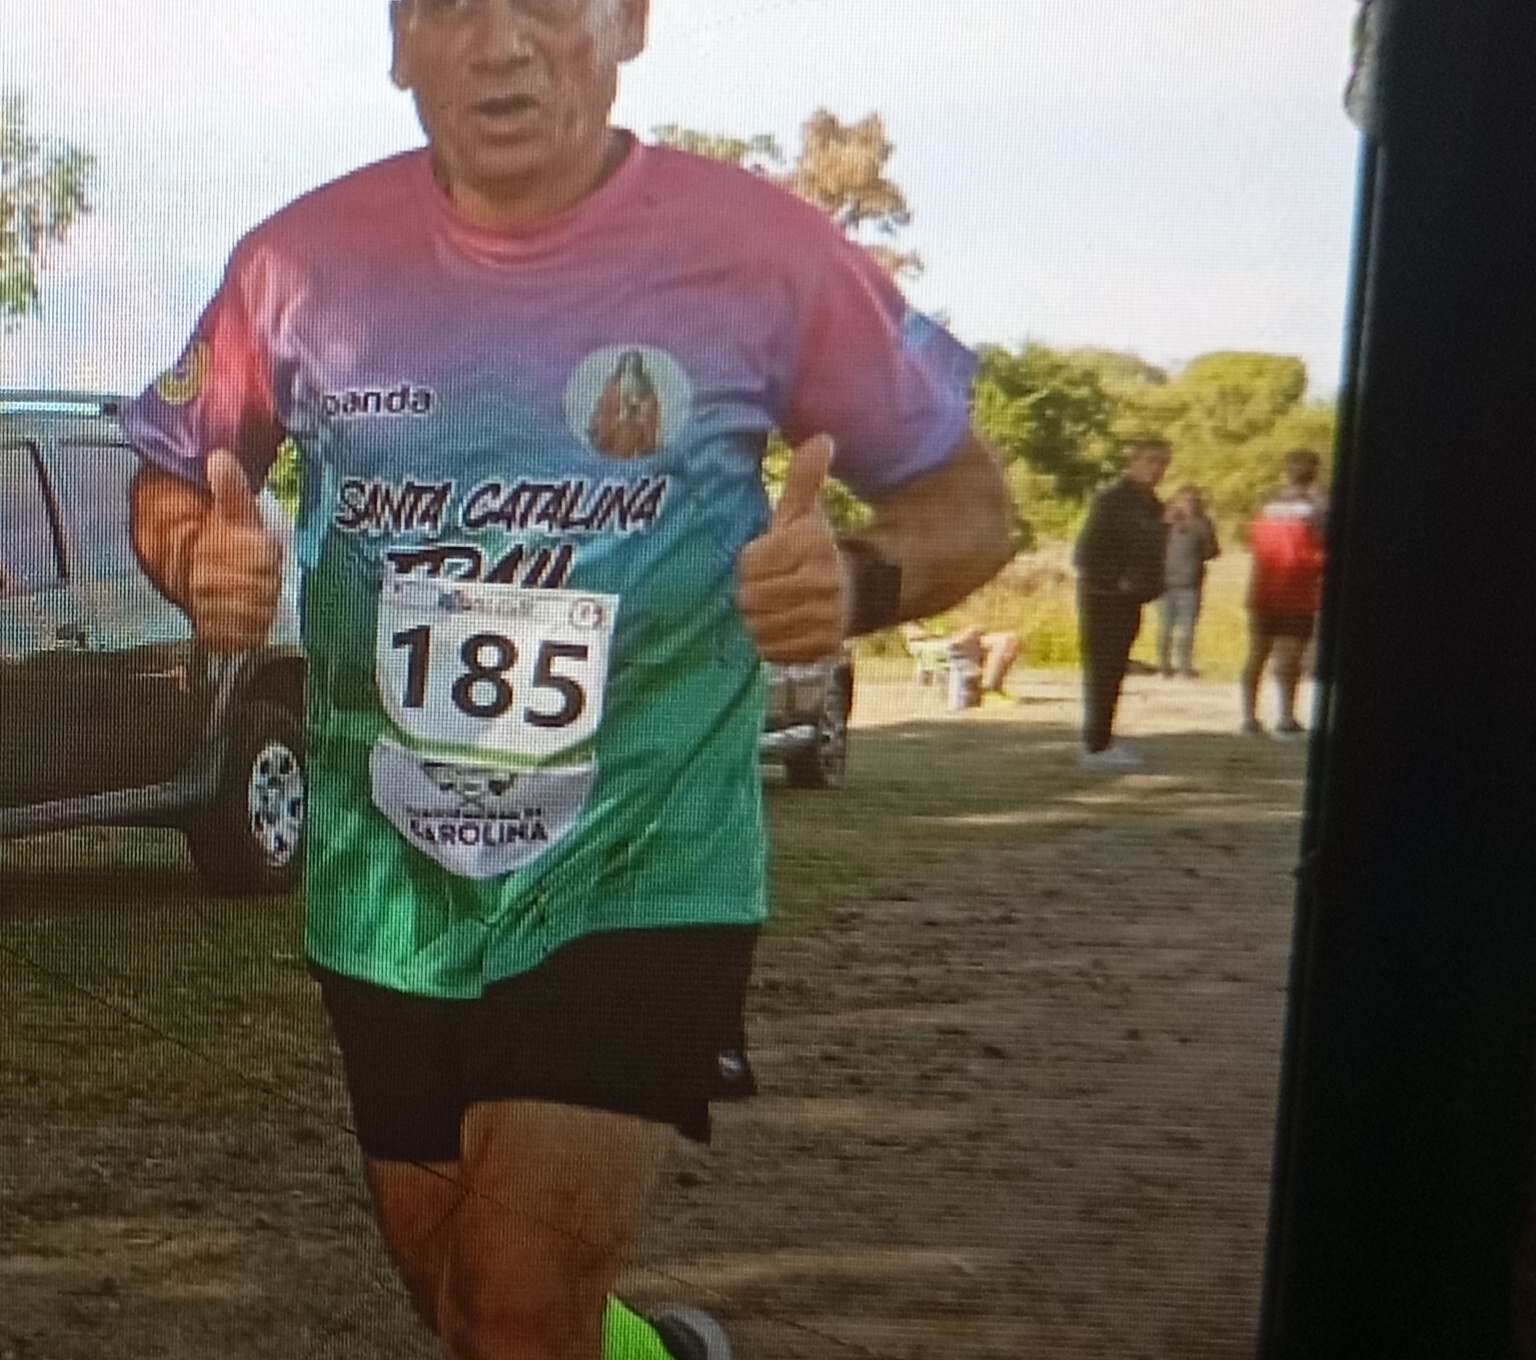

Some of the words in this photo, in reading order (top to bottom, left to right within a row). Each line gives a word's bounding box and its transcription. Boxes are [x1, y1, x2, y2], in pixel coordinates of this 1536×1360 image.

[335, 478, 453, 536] SANTA
[462, 475, 669, 533] CATALINA
[392, 625, 589, 728] 185
